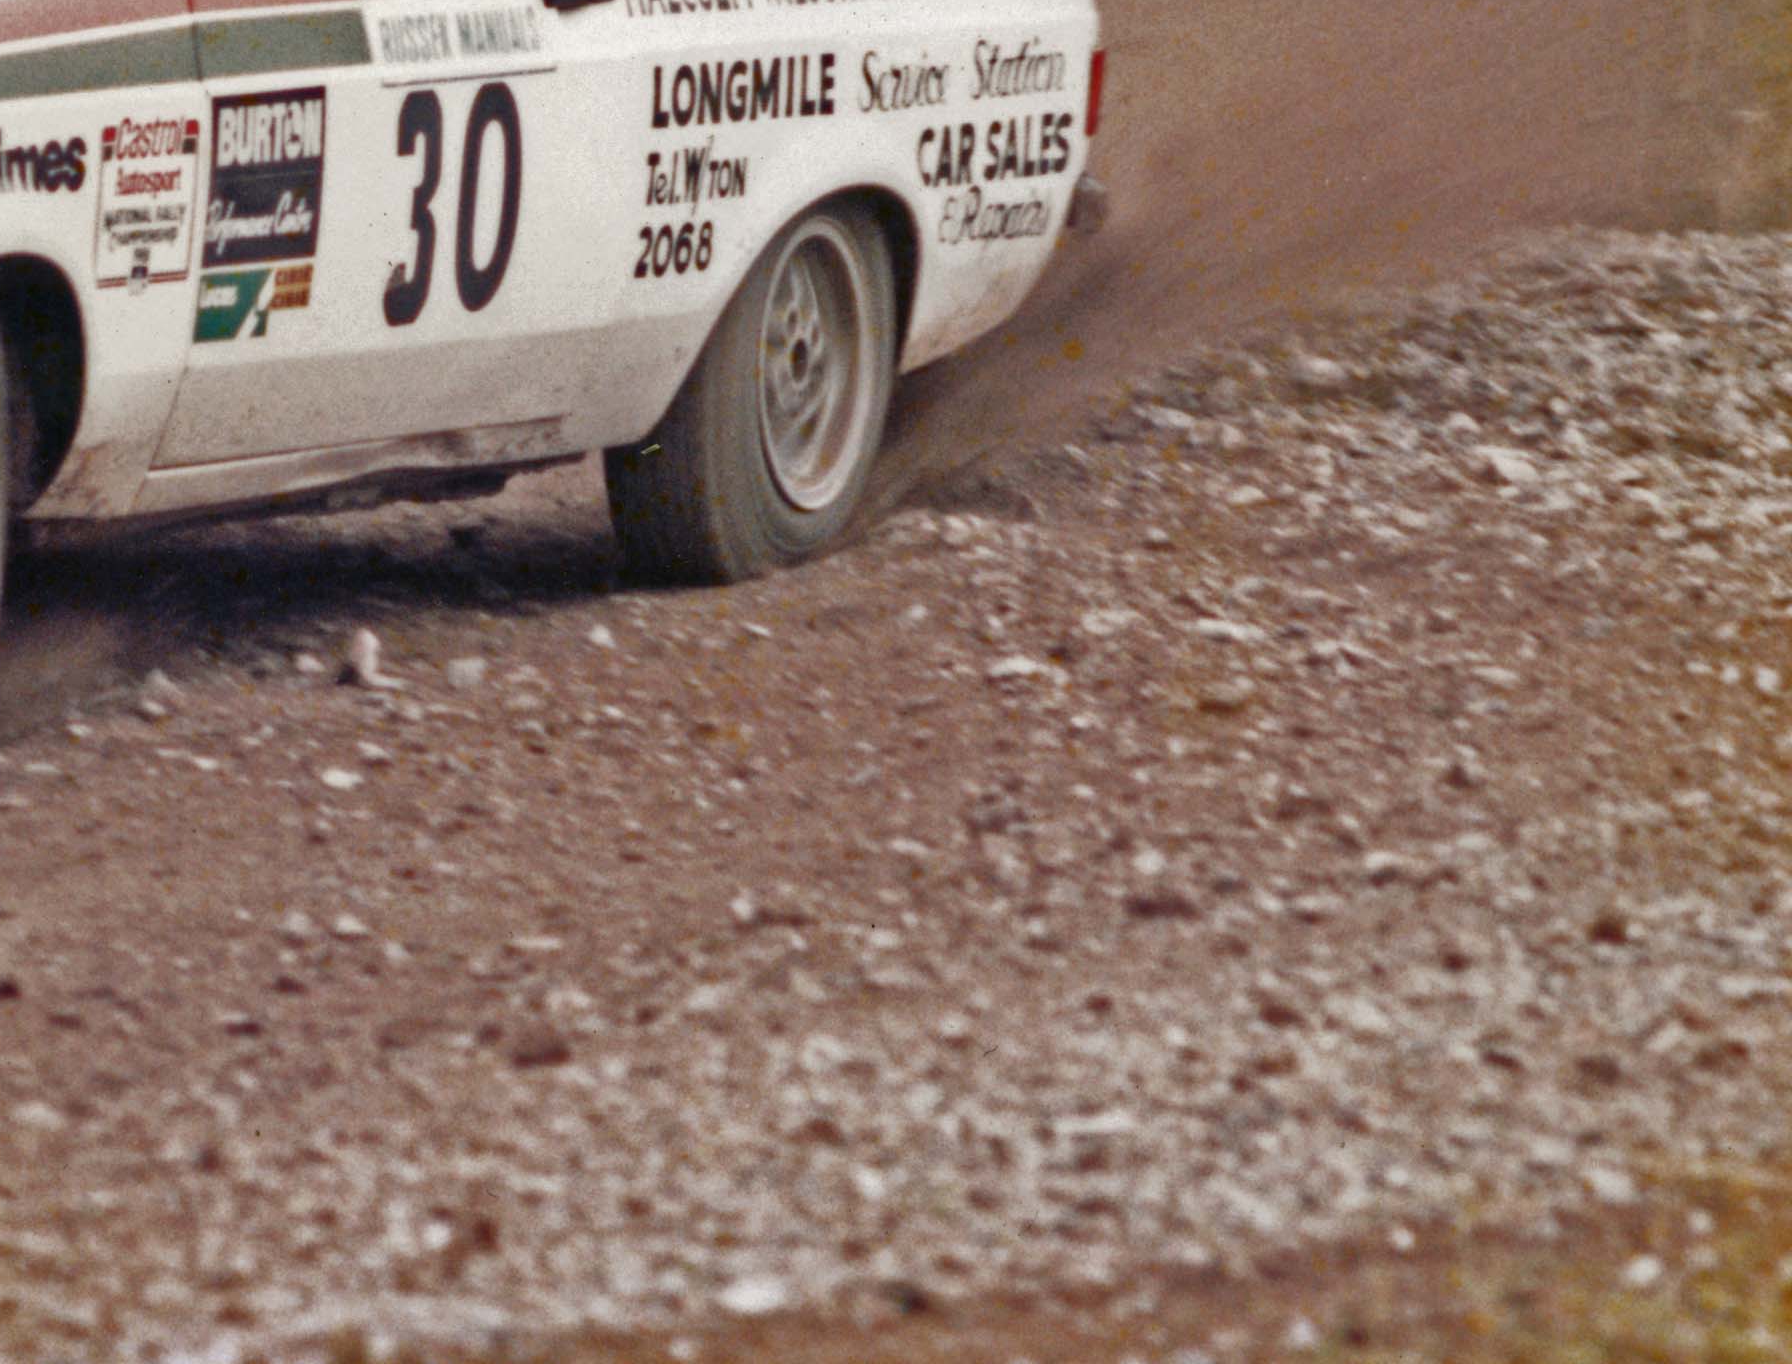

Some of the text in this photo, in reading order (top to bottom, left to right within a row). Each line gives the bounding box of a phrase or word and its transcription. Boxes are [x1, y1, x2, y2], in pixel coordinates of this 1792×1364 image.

[651, 52, 836, 129] LONGMILE
[971, 38, 1068, 100] Station
[115, 117, 184, 161] Castrol
[216, 99, 324, 168] BURTON
[918, 111, 1073, 188] CAR SALES
[381, 81, 523, 328] 30
[634, 219, 714, 279] 2068
